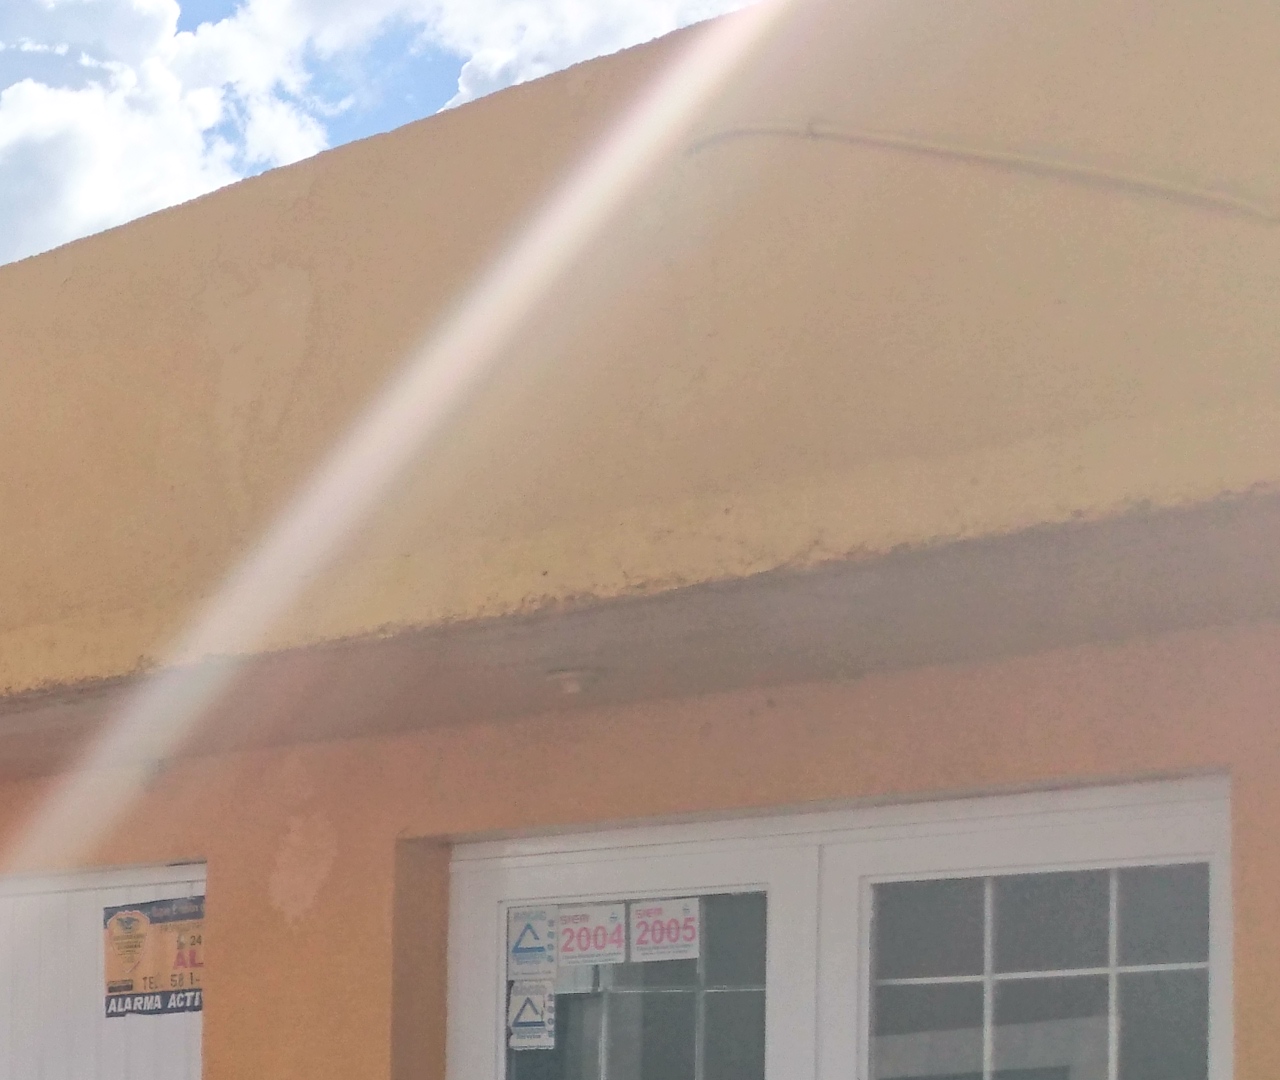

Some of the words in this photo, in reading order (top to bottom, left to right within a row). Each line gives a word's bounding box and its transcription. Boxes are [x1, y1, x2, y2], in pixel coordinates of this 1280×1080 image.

[561, 923, 625, 953] 2004
[635, 917, 697, 946] 2005
[107, 995, 162, 1013] ALARMA
